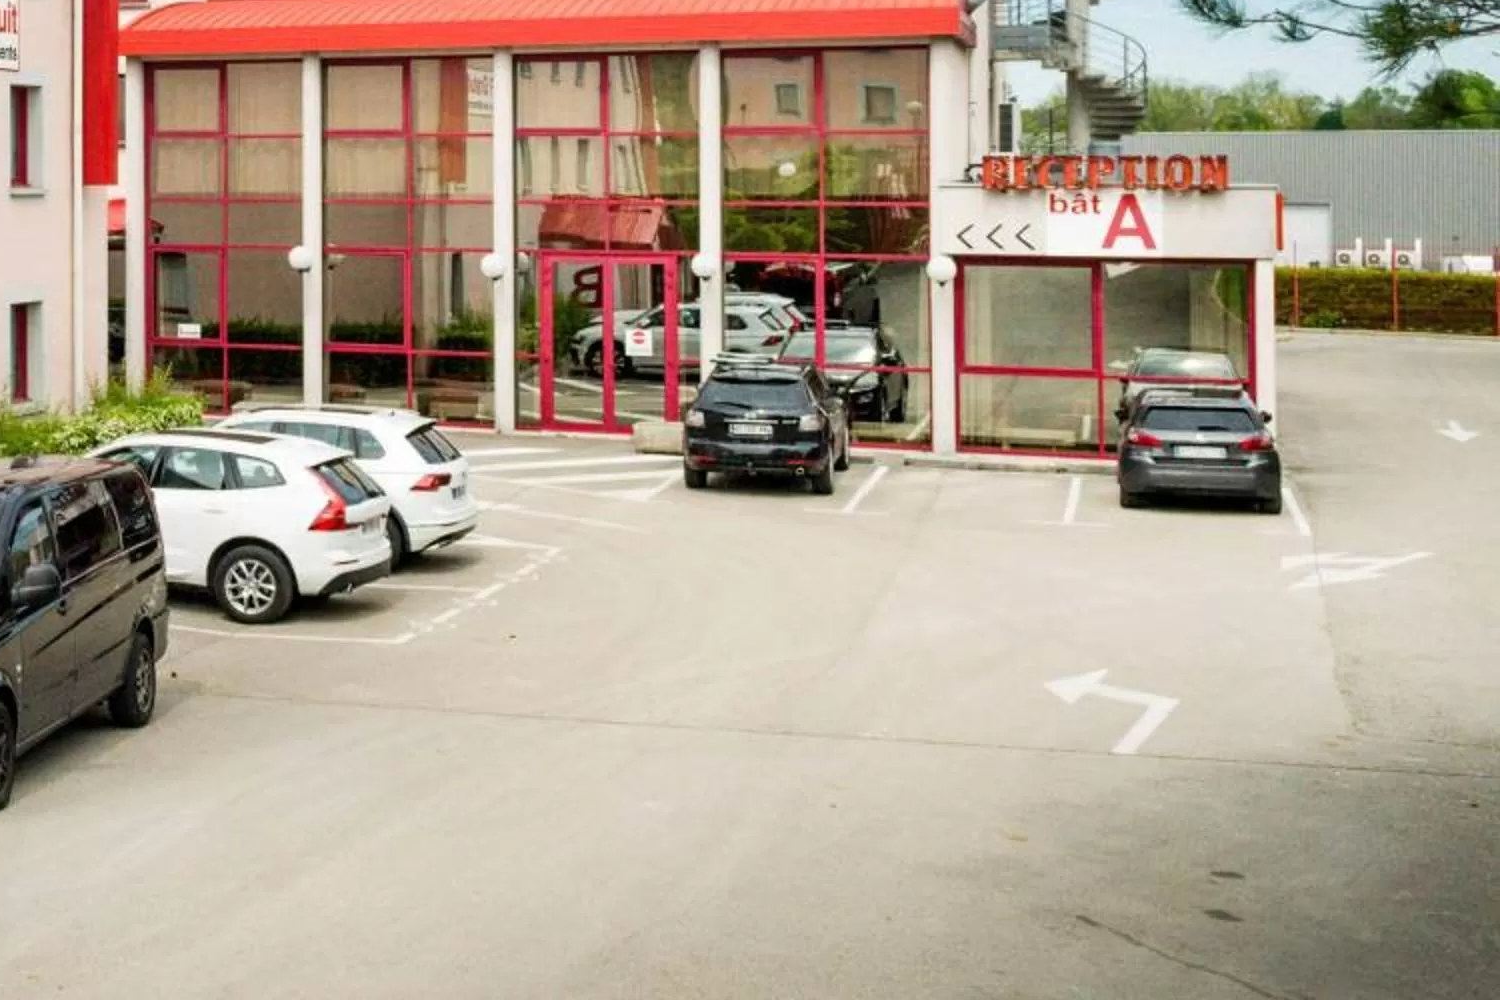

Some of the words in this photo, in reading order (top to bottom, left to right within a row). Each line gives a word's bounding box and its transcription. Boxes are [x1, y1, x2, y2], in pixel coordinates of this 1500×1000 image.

[982, 153, 1229, 192] RECEPTION
[1049, 193, 1100, 215] bât
[1102, 193, 1157, 249] A
